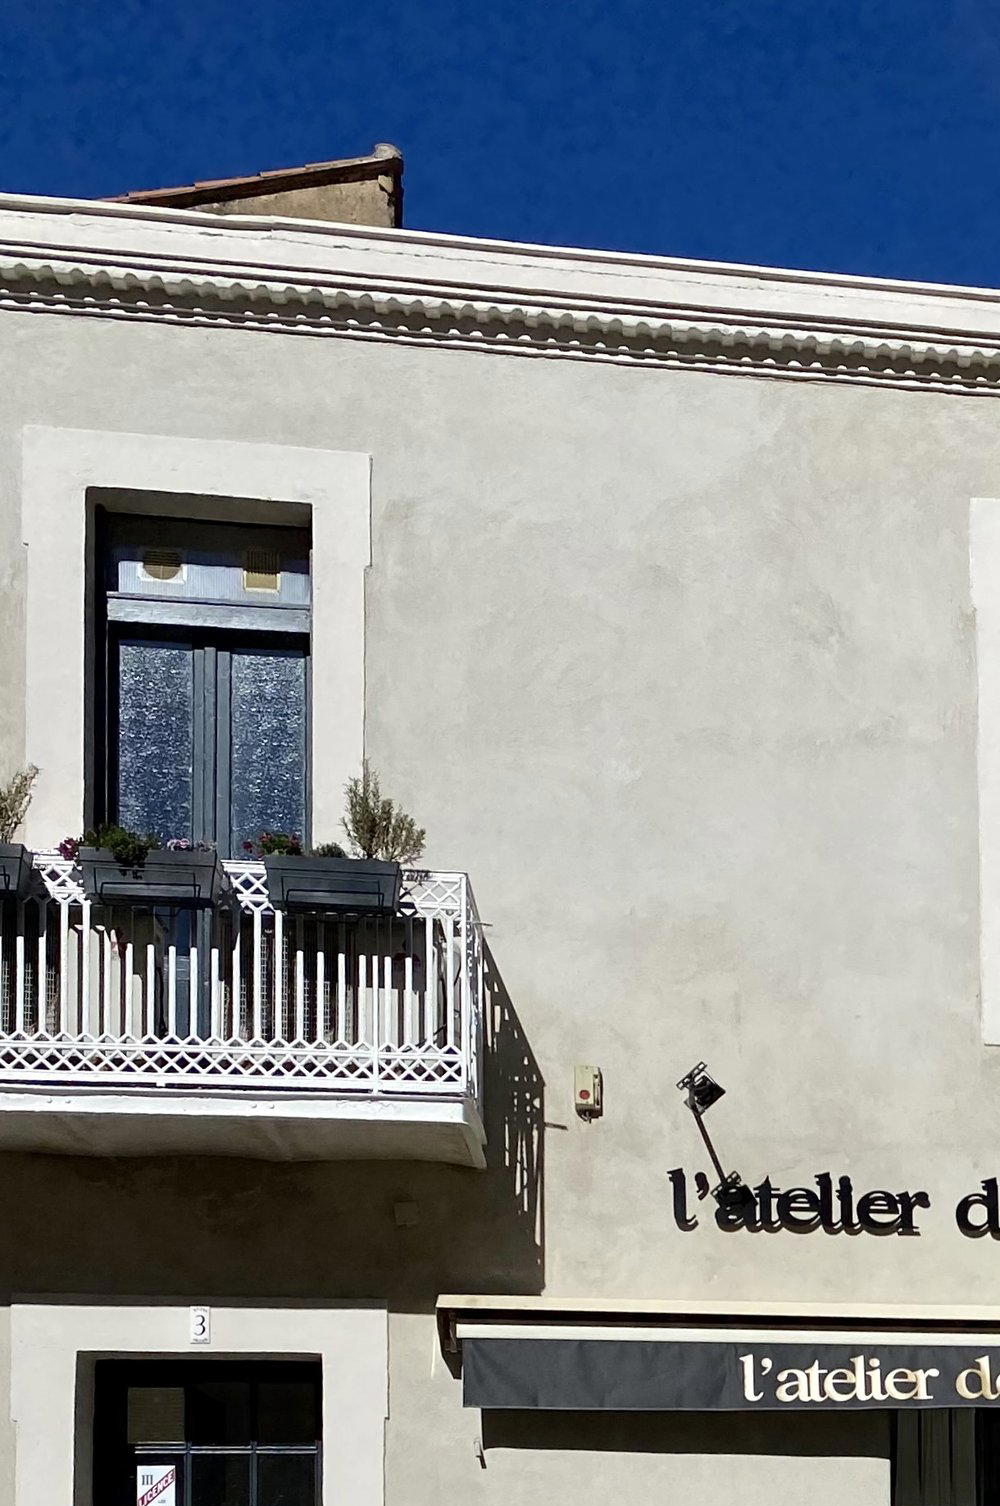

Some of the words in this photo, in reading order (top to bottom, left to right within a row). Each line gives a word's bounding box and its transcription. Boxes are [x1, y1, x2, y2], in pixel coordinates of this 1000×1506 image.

[667, 1168, 931, 1236] l'atelier
[194, 1314, 206, 1336] 3
[739, 1353, 940, 1402] l'atelier
